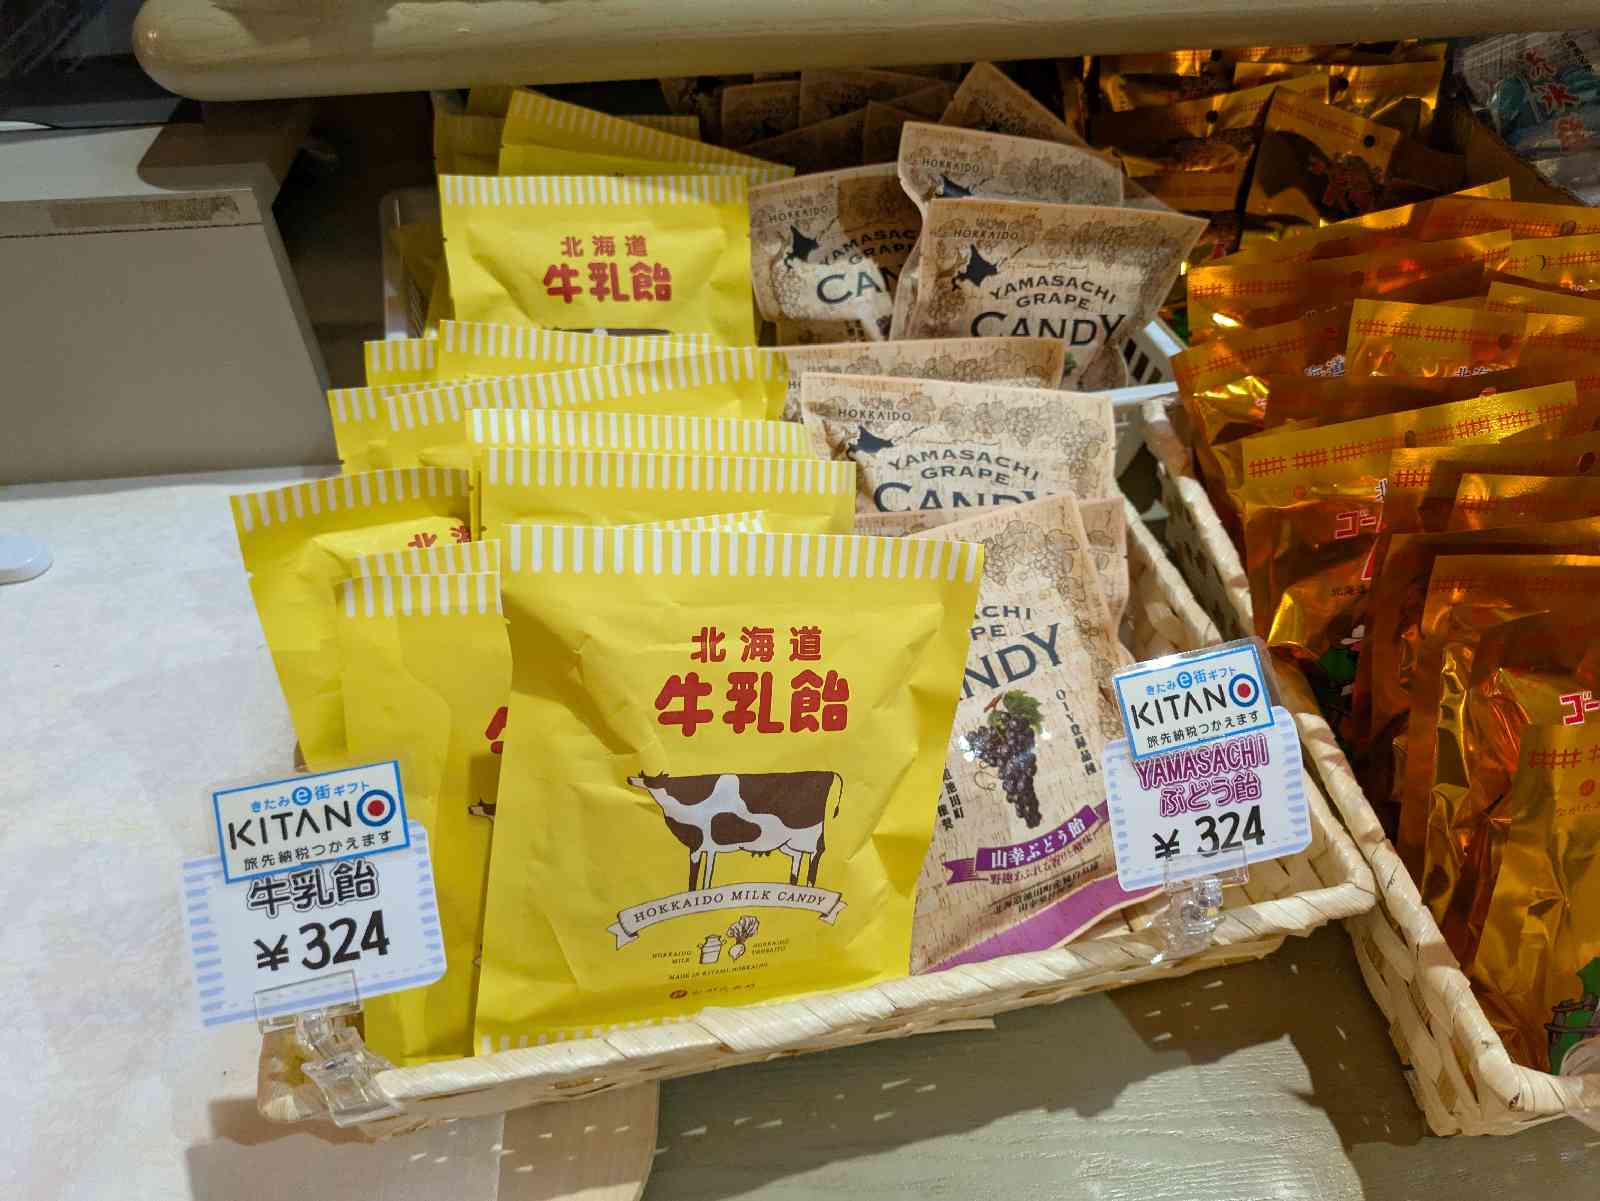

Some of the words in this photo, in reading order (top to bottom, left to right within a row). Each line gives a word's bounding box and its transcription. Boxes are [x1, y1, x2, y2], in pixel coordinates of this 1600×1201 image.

[921, 157, 980, 173] HOKKAIDO
[768, 205, 829, 224] HOKKAIDO
[561, 235, 648, 258] 北海道
[953, 229, 1019, 241] HOKKAIDO
[543, 261, 672, 304] 牛乳飴
[989, 275, 1117, 305] YAMASACHI
[1016, 292, 1090, 311] GRAPE
[970, 311, 1127, 347] CANDY
[838, 408, 912, 422] HOKKAIDO
[888, 449, 1040, 481] YAMASACHI
[921, 465, 1011, 487] GRAPE
[690, 625, 823, 664] 北海道
[654, 668, 850, 738] 牛乳飴
[1147, 710, 1260, 748] 旅先納税つかえます
[1133, 733, 1270, 791] YAMASACHI
[1160, 768, 1262, 818] ぶどう飴
[244, 830, 392, 872] 旅先納税つかえます
[991, 817, 1086, 870] 山幸ぶどう飴
[247, 857, 379, 919] 牛乳飴
[634, 893, 724, 924] HOKKAIDO
[731, 890, 771, 902] MILK
[777, 890, 827, 907] CANDY
